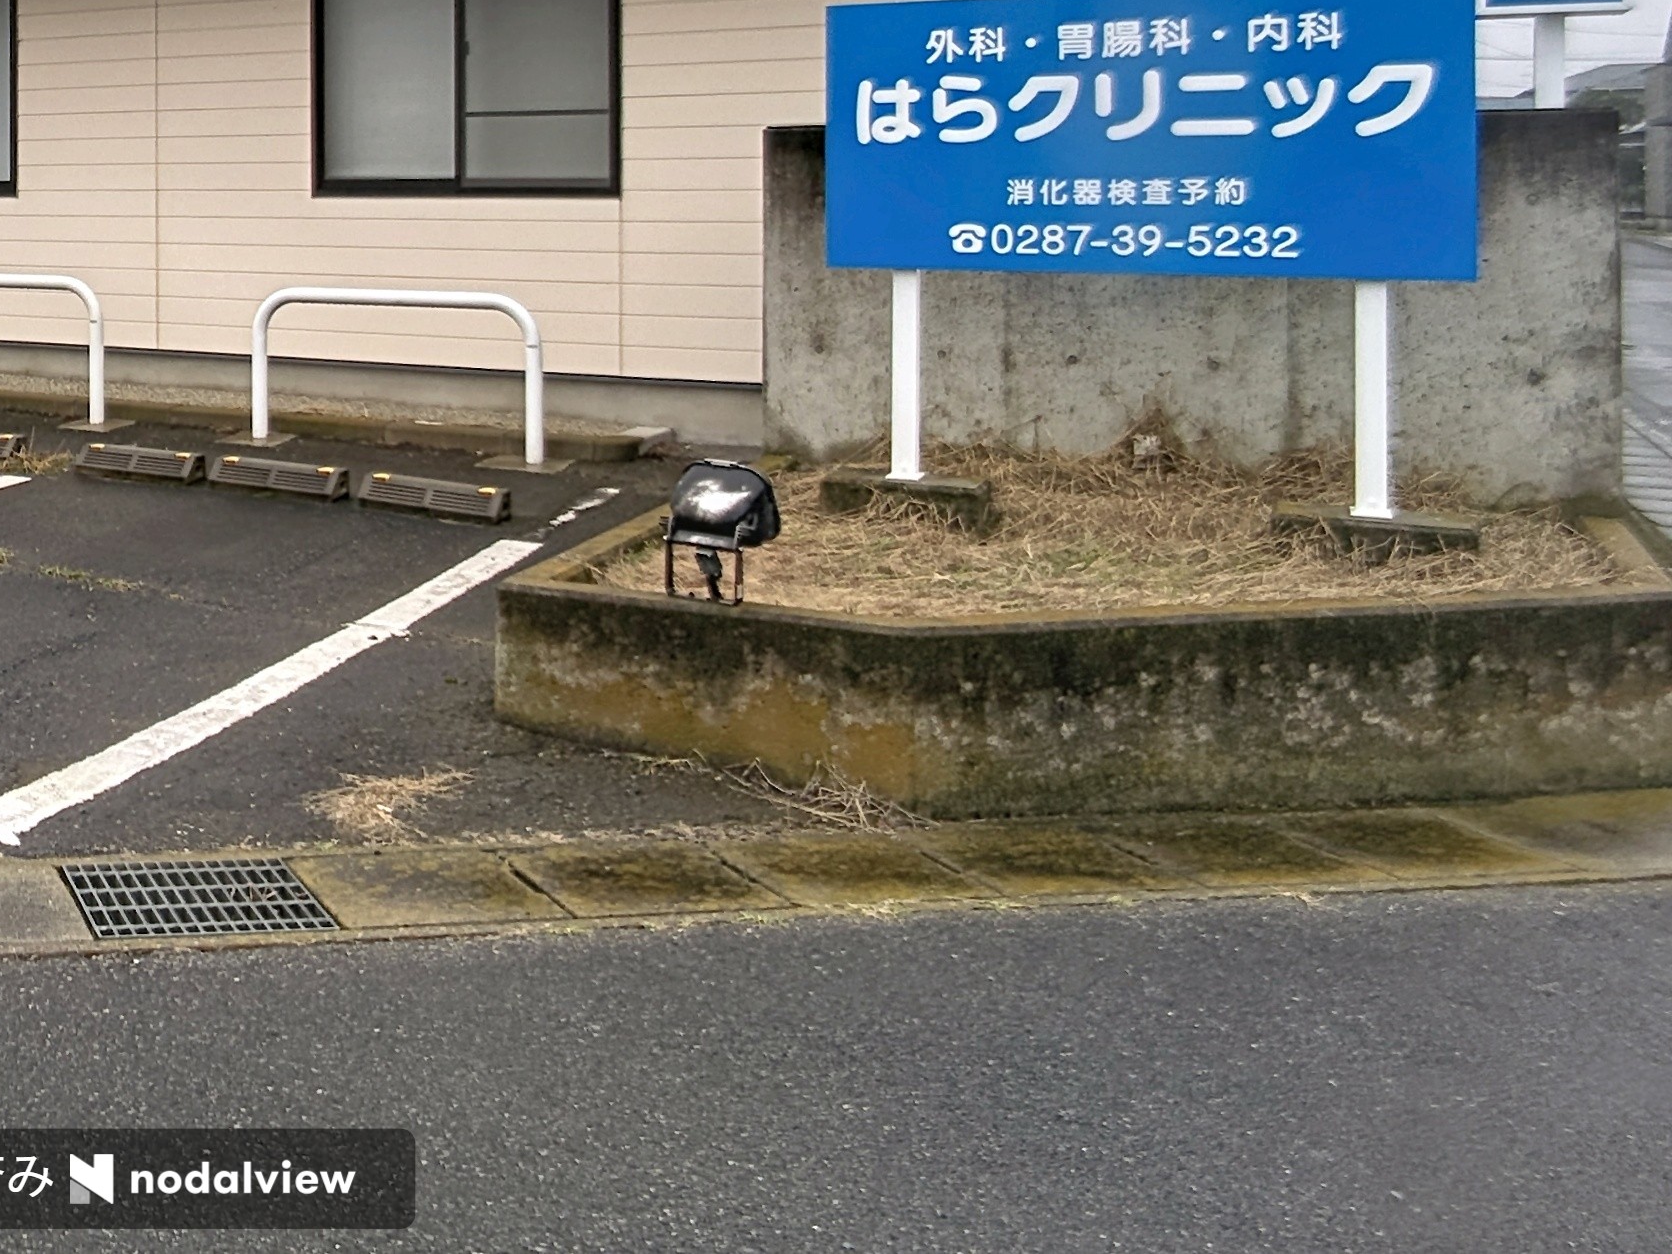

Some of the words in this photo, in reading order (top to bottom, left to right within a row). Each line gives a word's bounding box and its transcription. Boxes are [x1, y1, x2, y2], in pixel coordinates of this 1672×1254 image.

[925, 11, 1343, 64] 外科・胃腸科・内科
[856, 63, 1434, 145] はらクリニック
[1006, 177, 1247, 206] 消化器検査予約
[991, 223, 1300, 258] 0287-39-5232
